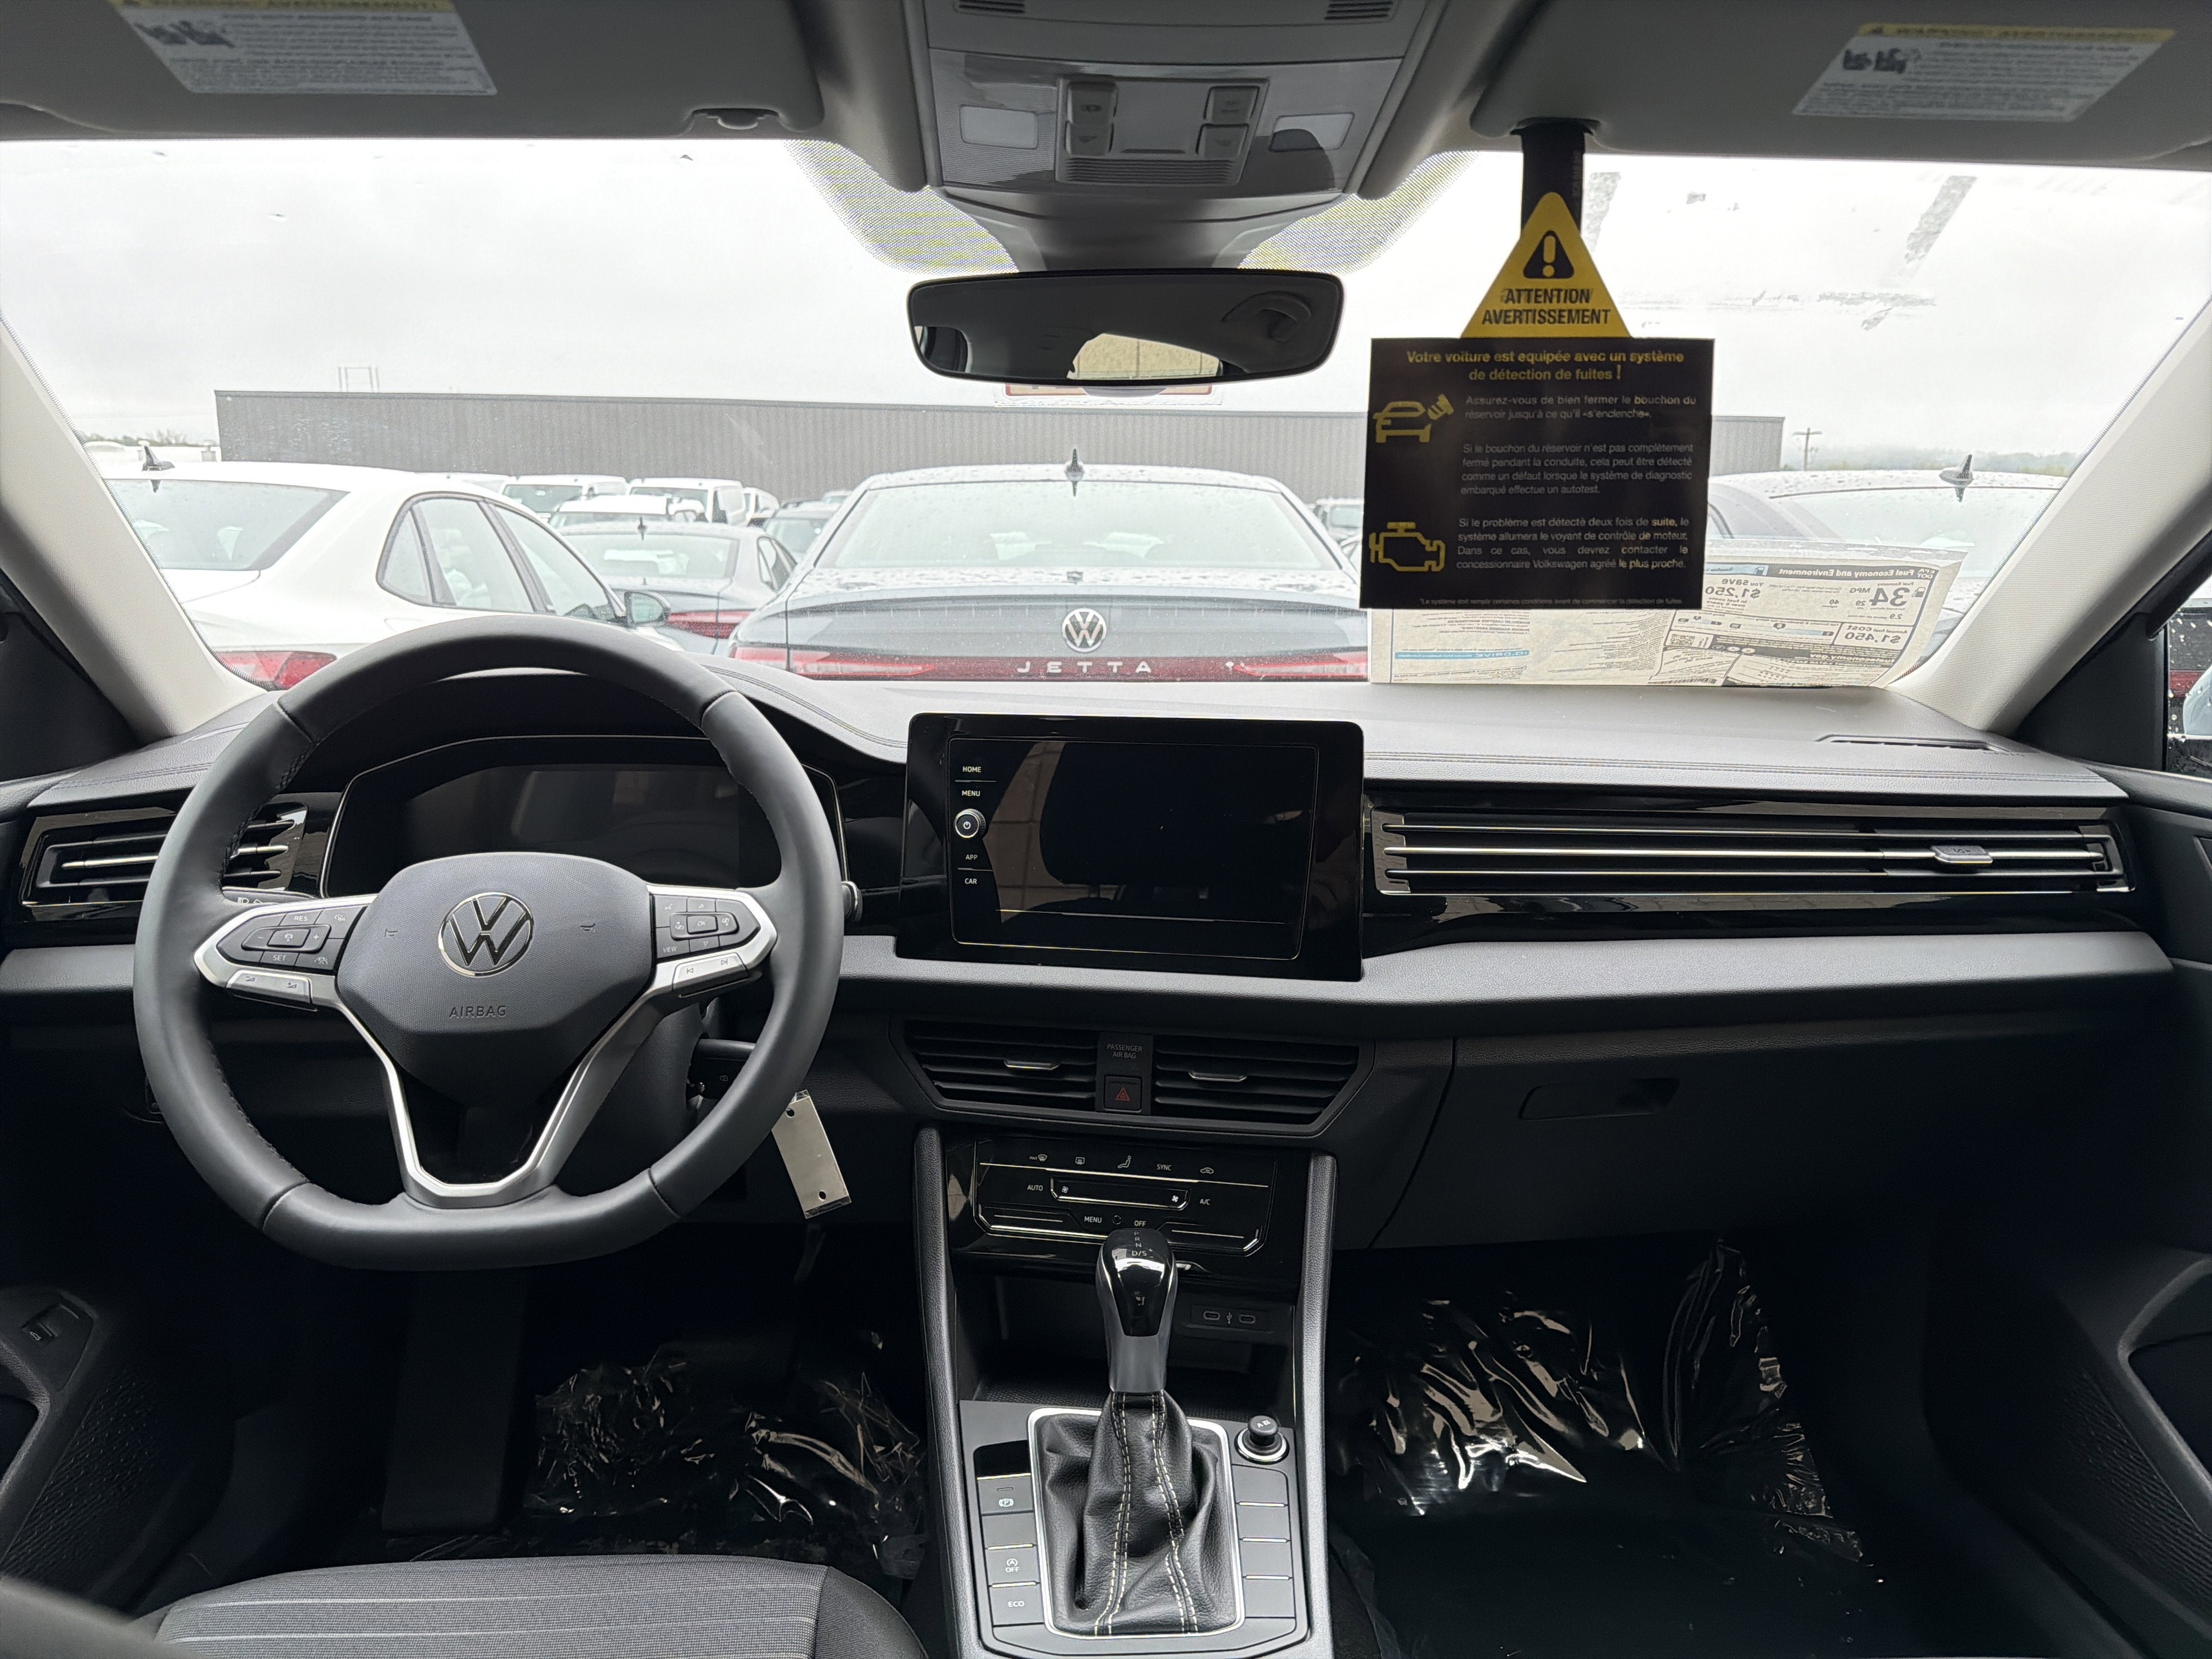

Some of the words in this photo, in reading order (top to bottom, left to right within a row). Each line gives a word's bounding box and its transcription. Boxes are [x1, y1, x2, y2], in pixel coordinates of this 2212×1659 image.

[1503, 289, 1590, 304] ATTENTION
[1481, 309, 1610, 325] AVERTISSEMENT
[1407, 351, 1441, 363] Votre
[1444, 351, 1490, 363] voiture
[1494, 352, 1515, 363] est
[1574, 353, 1605, 363] avec
[1609, 353, 1626, 363] un
[1629, 351, 1684, 366] système
[1469, 368, 1487, 380] de
[1489, 368, 1552, 380] détection
[1555, 368, 1572, 380] de
[1575, 368, 1613, 380] fuites
[1616, 364, 1622, 380] !
[1465, 396, 1537, 405] Assurez-vous
[1541, 396, 1554, 405] de
[1557, 396, 1581, 405] bien
[1584, 396, 1618, 404] fermer
[1621, 396, 1631, 404] le
[1634, 396, 1680, 404] bouchon
[1683, 396, 1697, 404] du
[1465, 409, 1505, 419] réservoir
[1559, 409, 1581, 420] qu'il
[1463, 444, 1472, 453] Si
[1475, 444, 1483, 453] le
[1485, 444, 1526, 453] bouchon
[1527, 444, 1540, 453] du
[1609, 445, 1626, 455] pas
[1492, 458, 1531, 469] pendant
[1533, 458, 1542, 466] la
[1590, 458, 1610, 466] cela
[1612, 459, 1634, 468] peut
[1635, 457, 1655, 466] être
[1543, 471, 1578, 482] lorsque
[1579, 471, 1588, 481] le
[1630, 471, 1643, 480] de
[1645, 471, 1692, 482] diagnostic
[1508, 485, 1545, 494] effectue
[1459, 518, 1468, 527] Si
[1471, 518, 1480, 527] le
[1588, 517, 1612, 526] deux
[1615, 517, 1633, 526] fois
[1635, 517, 1649, 526] de
[1651, 517, 1678, 527] suite,
[1680, 517, 1689, 526] le
[1498, 532, 1538, 541] allumera
[1540, 532, 1548, 541] le
[1550, 532, 1582, 542] voyant
[1584, 532, 1596, 540] de
[1638, 532, 1651, 540] de
[1457, 546, 1482, 555] Dans
[1510, 548, 1531, 556] cas,
[1542, 546, 1566, 555] vous
[1577, 545, 1610, 554] devrez
[1621, 546, 1668, 554] contacter
[1679, 545, 1689, 554] le
[1532, 560, 1588, 571] Volkswagen
[1618, 559, 1627, 568] le
[1629, 559, 1649, 569] plus
[1651, 558, 1686, 569] proche.
[1017, 661, 1152, 673] JETTA
[449, 1005, 507, 1018] AIRBAG
[1107, 1043, 1143, 1052] PASSENGER
